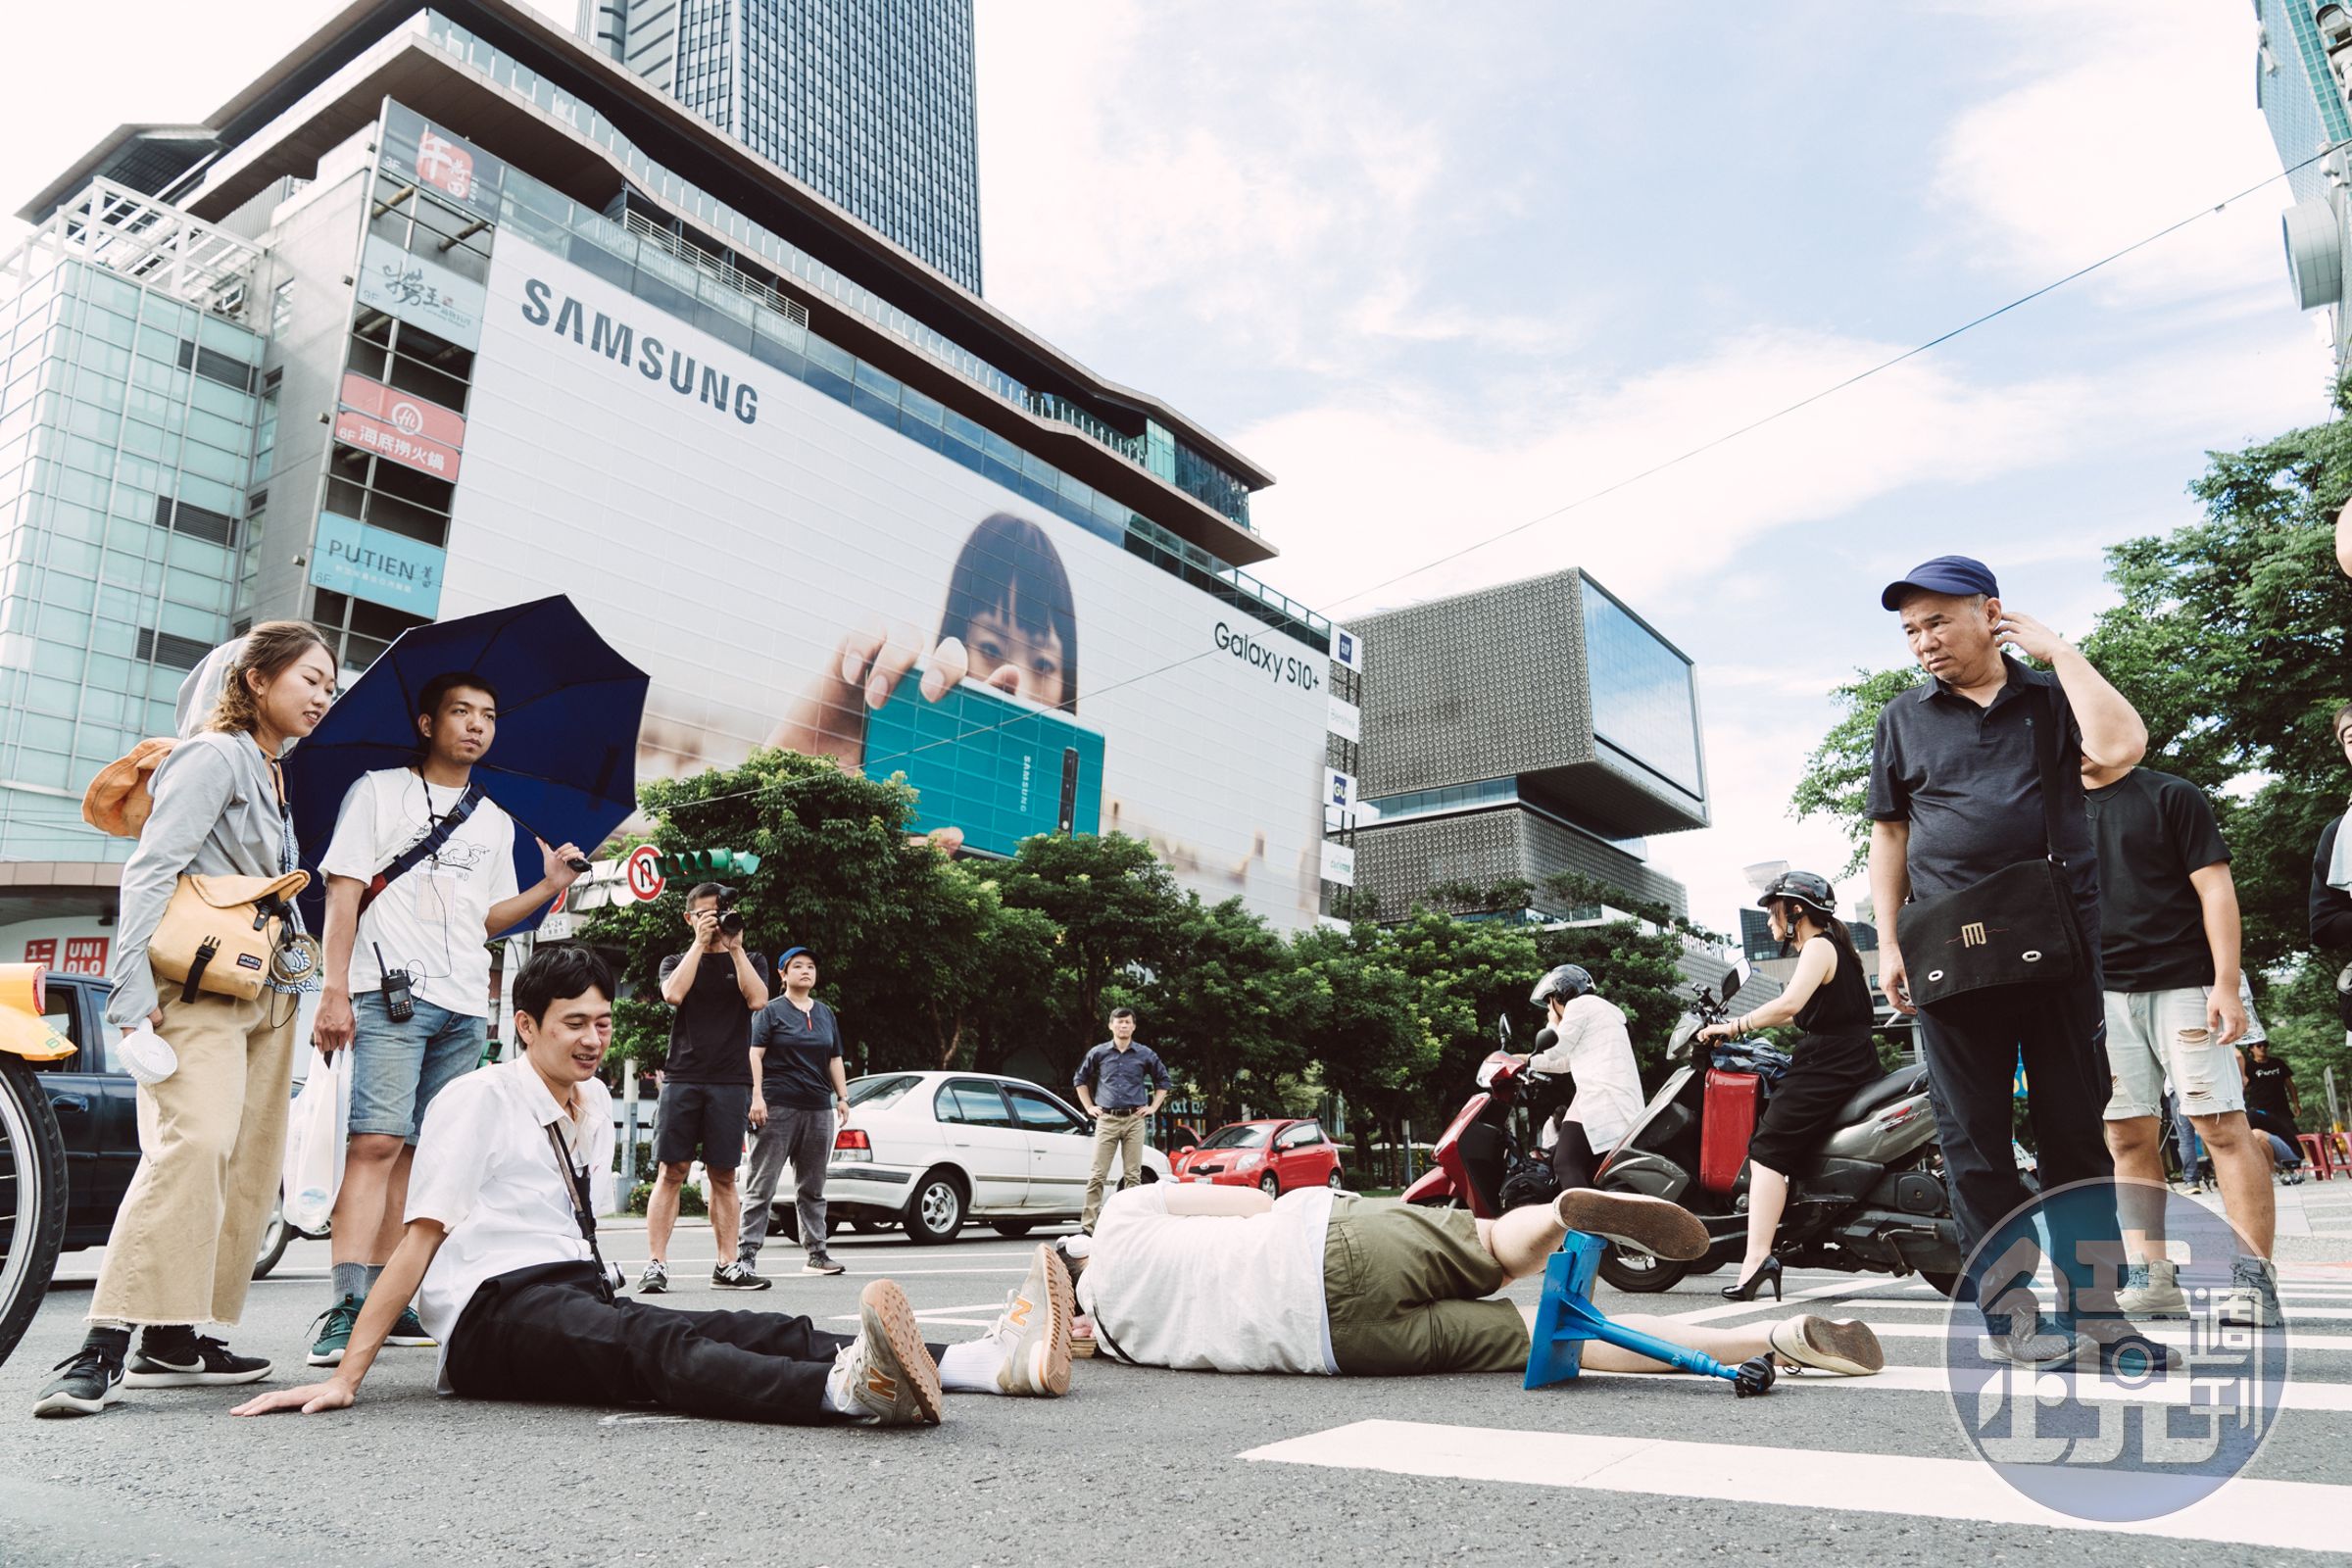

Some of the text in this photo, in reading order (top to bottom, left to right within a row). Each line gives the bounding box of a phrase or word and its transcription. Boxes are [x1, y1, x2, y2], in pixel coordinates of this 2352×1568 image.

[522, 278, 759, 424] SAMSUNG
[398, 409, 416, 428] Hi
[339, 424, 445, 471] 6F 海底撈火鍋
[315, 571, 332, 584] 6F
[328, 539, 415, 580] PUTIEN
[1214, 621, 1319, 691] Galaxy S10+
[1020, 755, 1031, 812] SAMSUNG
[1334, 782, 1348, 799] GU
[69, 942, 101, 958] UNI
